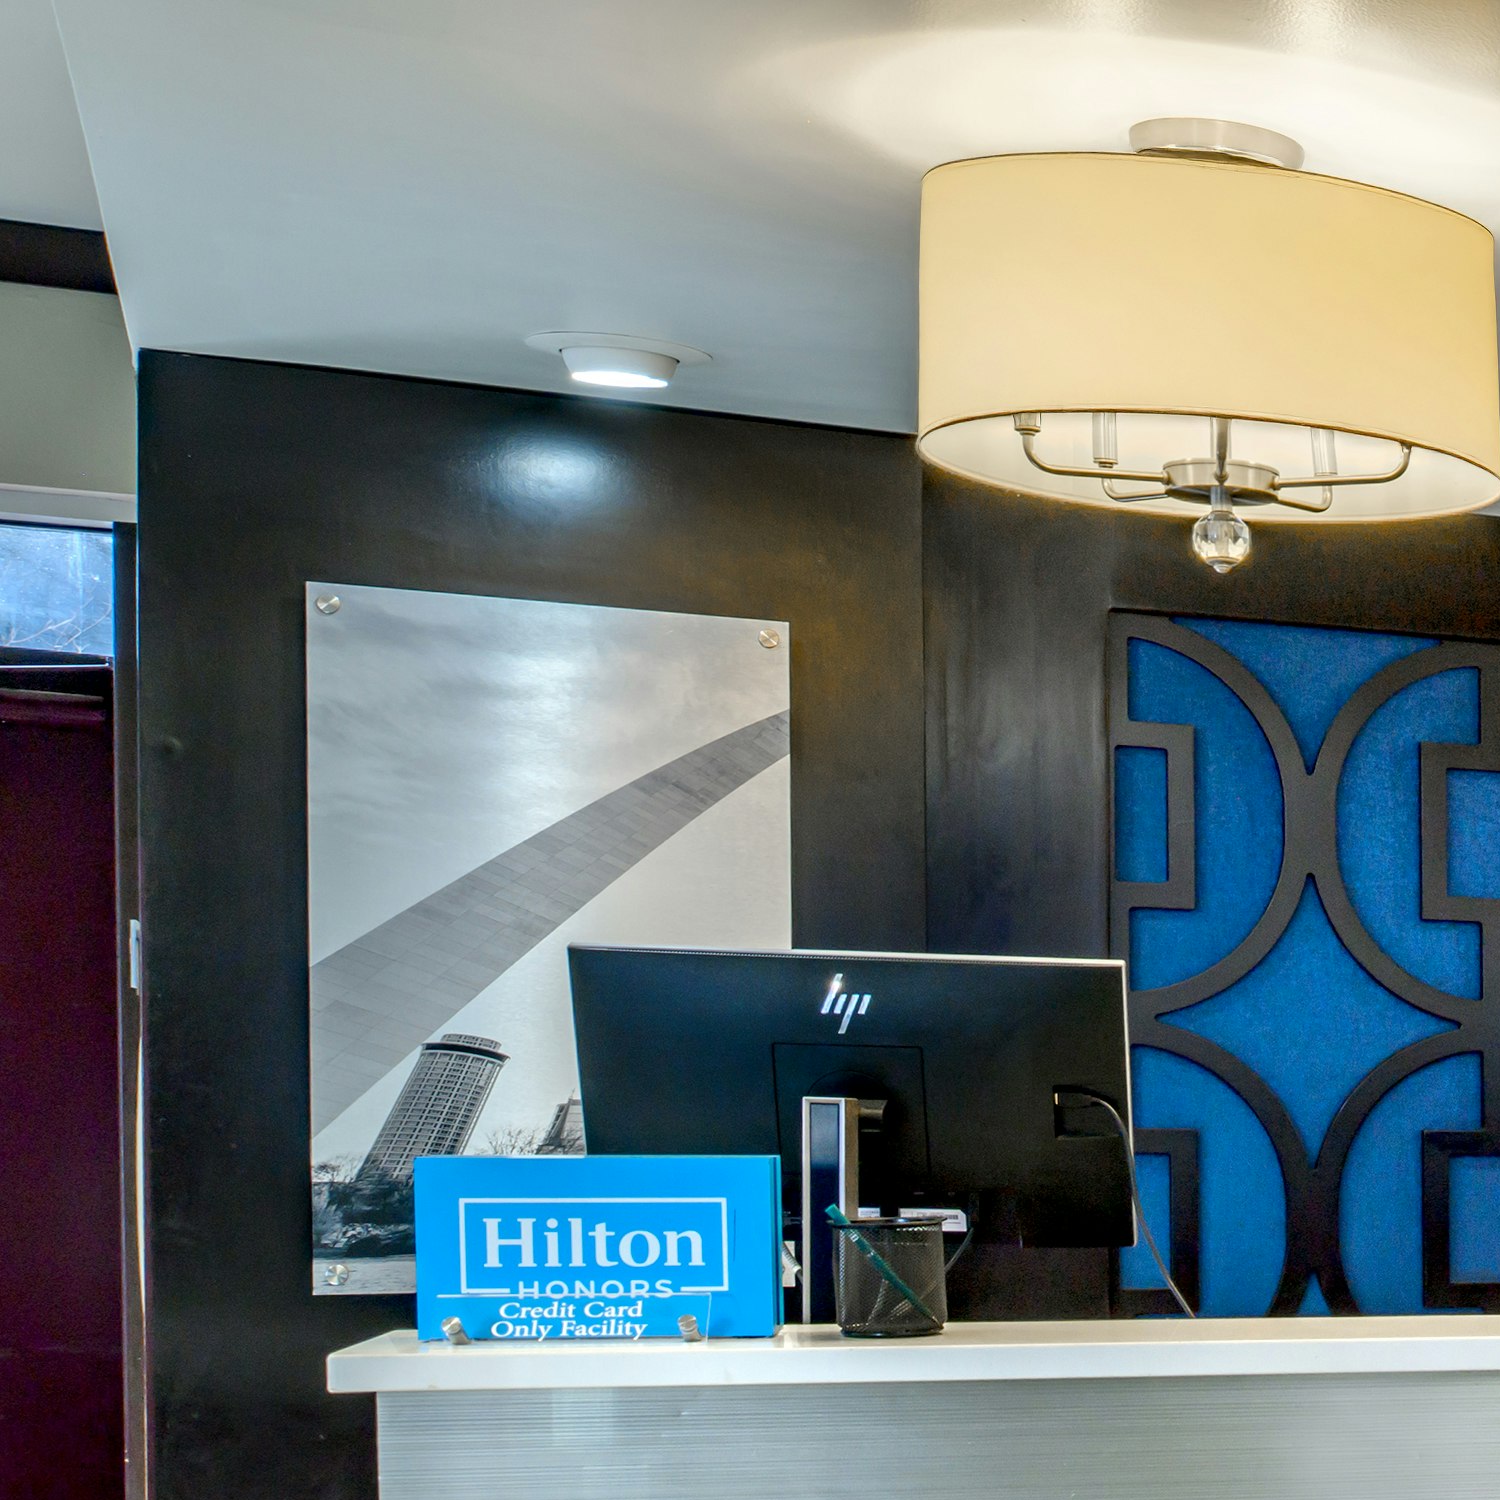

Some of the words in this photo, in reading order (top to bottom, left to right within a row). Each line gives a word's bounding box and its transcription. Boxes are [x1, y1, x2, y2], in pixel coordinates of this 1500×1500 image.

[820, 973, 872, 1034] hp
[483, 1217, 706, 1268] Hilton
[518, 1279, 674, 1300] HONORS
[500, 1301, 576, 1319] Credit
[584, 1300, 643, 1318] Card
[491, 1321, 554, 1342] Only
[561, 1320, 648, 1341] Facility
